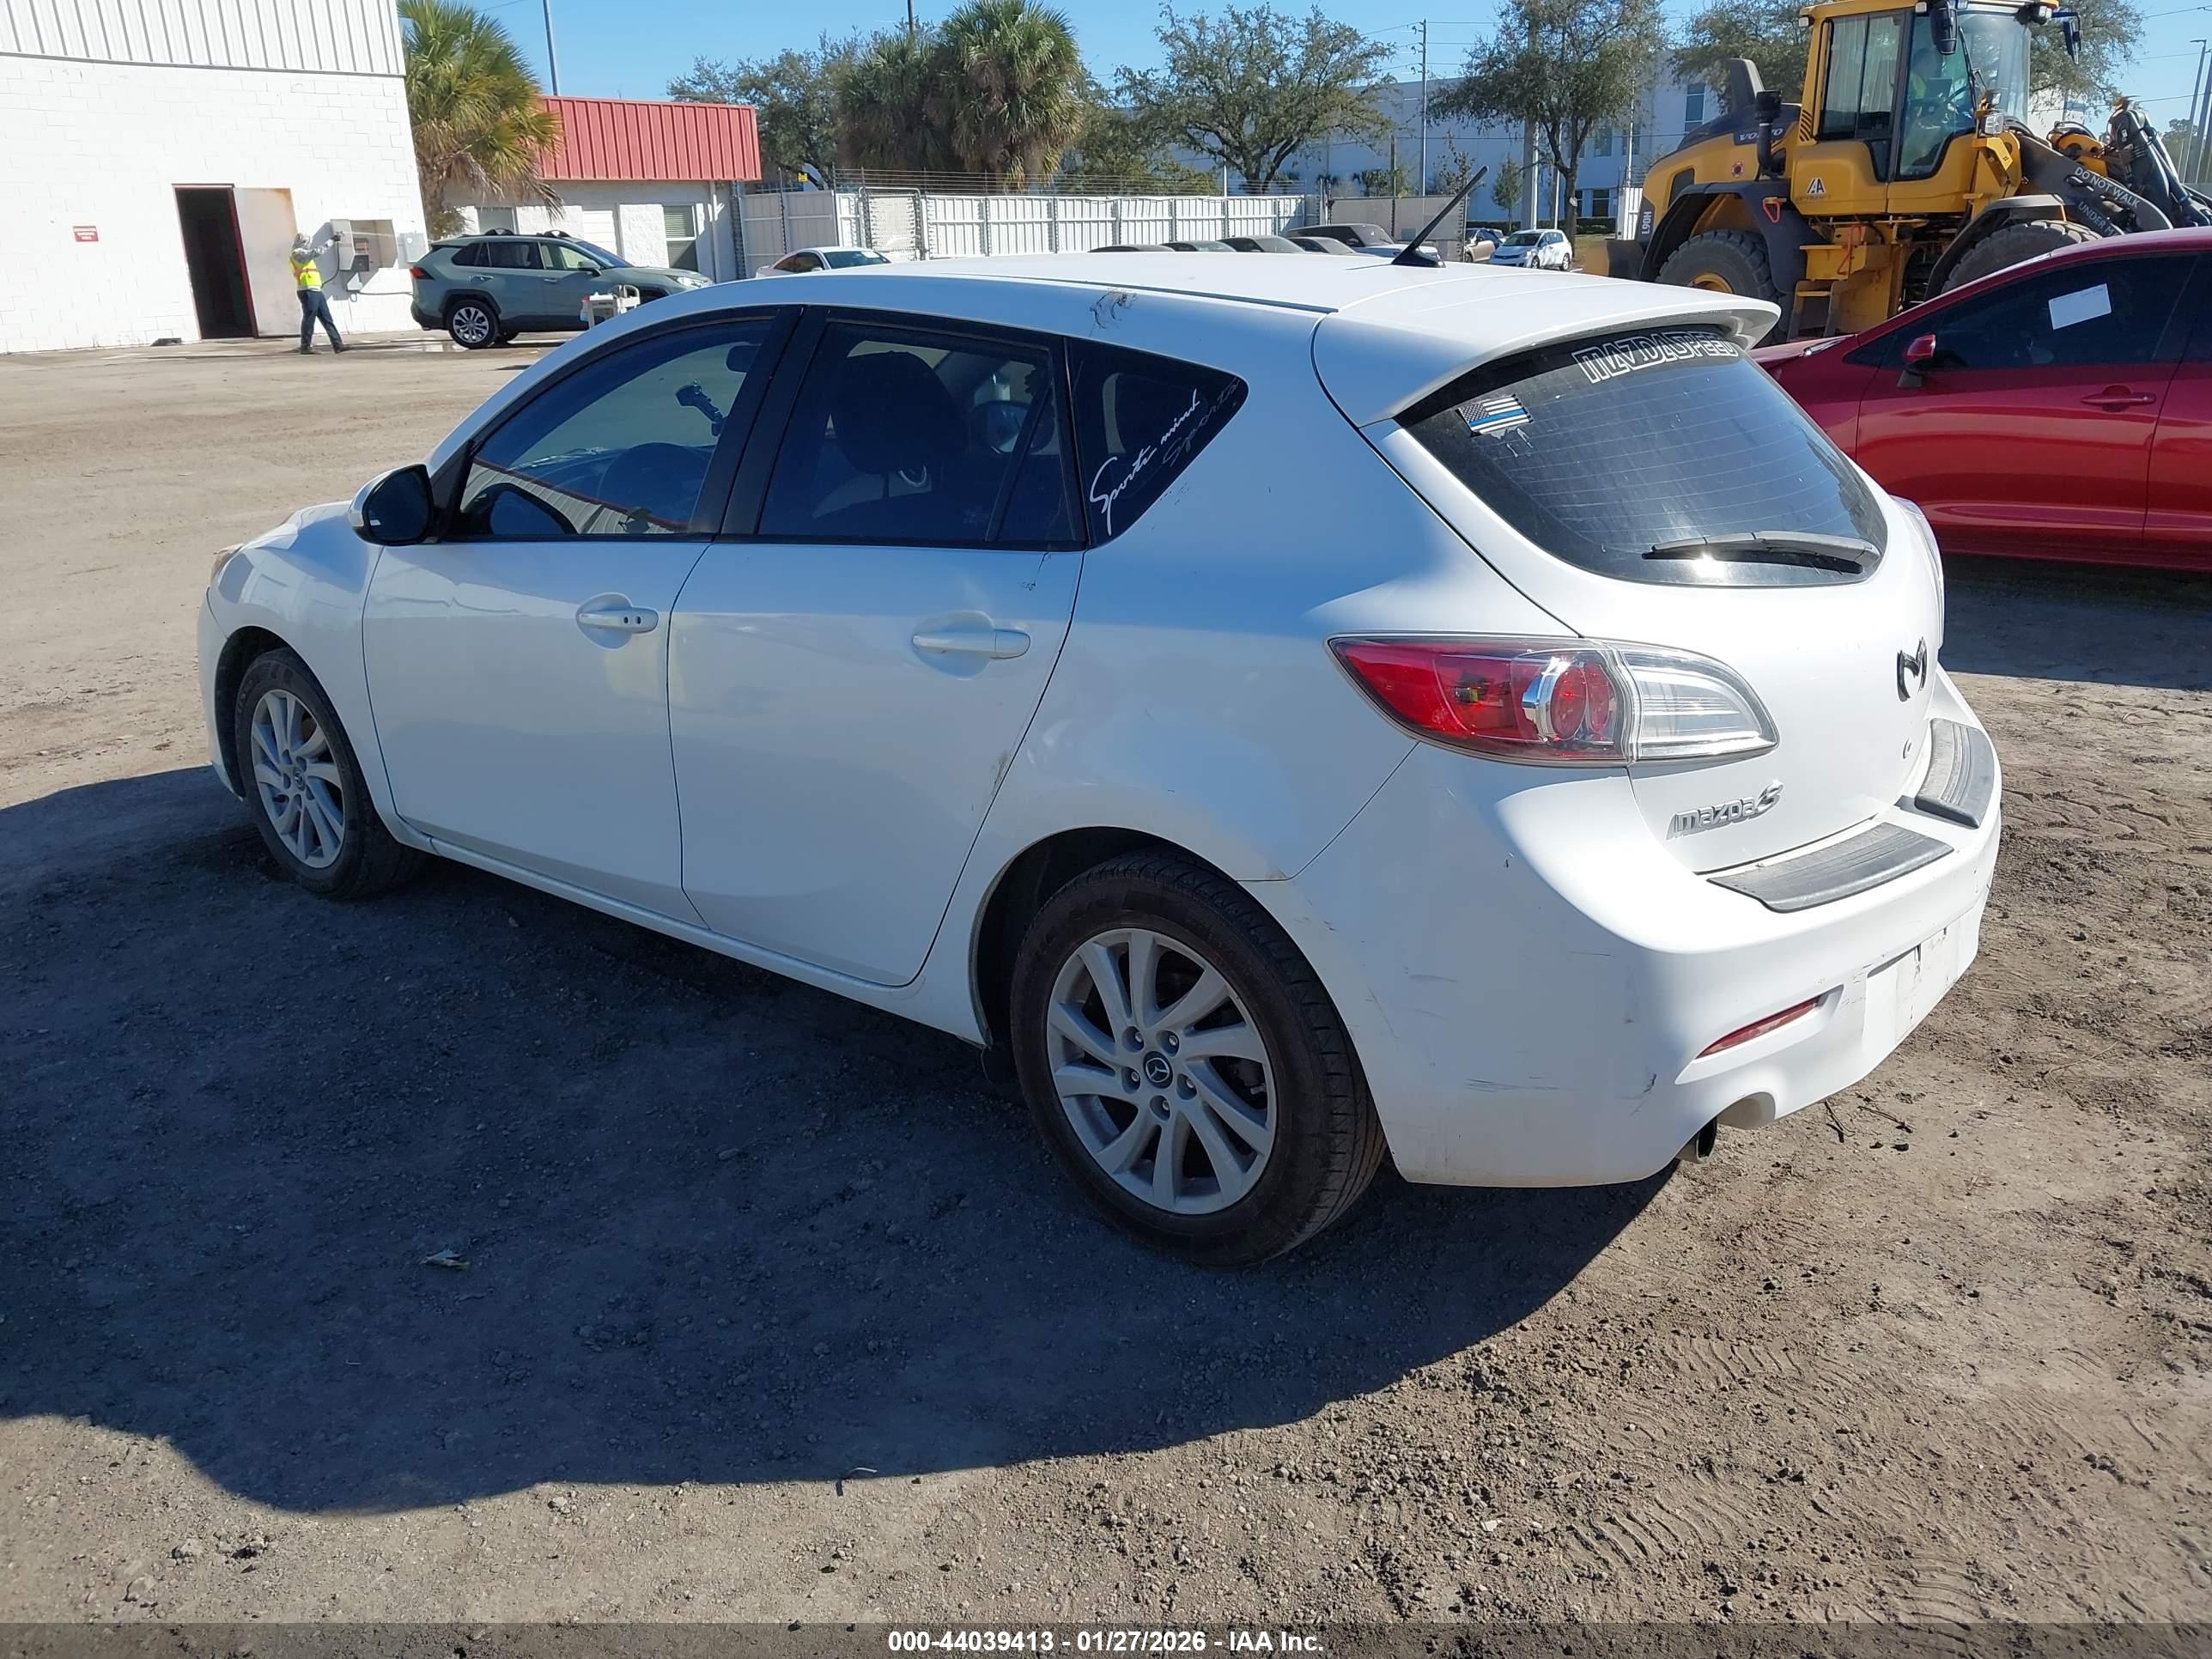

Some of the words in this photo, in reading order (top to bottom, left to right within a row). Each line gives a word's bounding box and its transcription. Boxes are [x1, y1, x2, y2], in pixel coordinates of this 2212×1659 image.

[1739, 127, 1784, 141] VOO
[2075, 166, 2090, 179] DO
[2089, 175, 2112, 193] NOT
[2113, 187, 2142, 209] WALK
[1641, 210, 1652, 234] L90H
[2078, 201, 2107, 229] UNDER
[1571, 331, 1739, 384] MAZDASPEED
